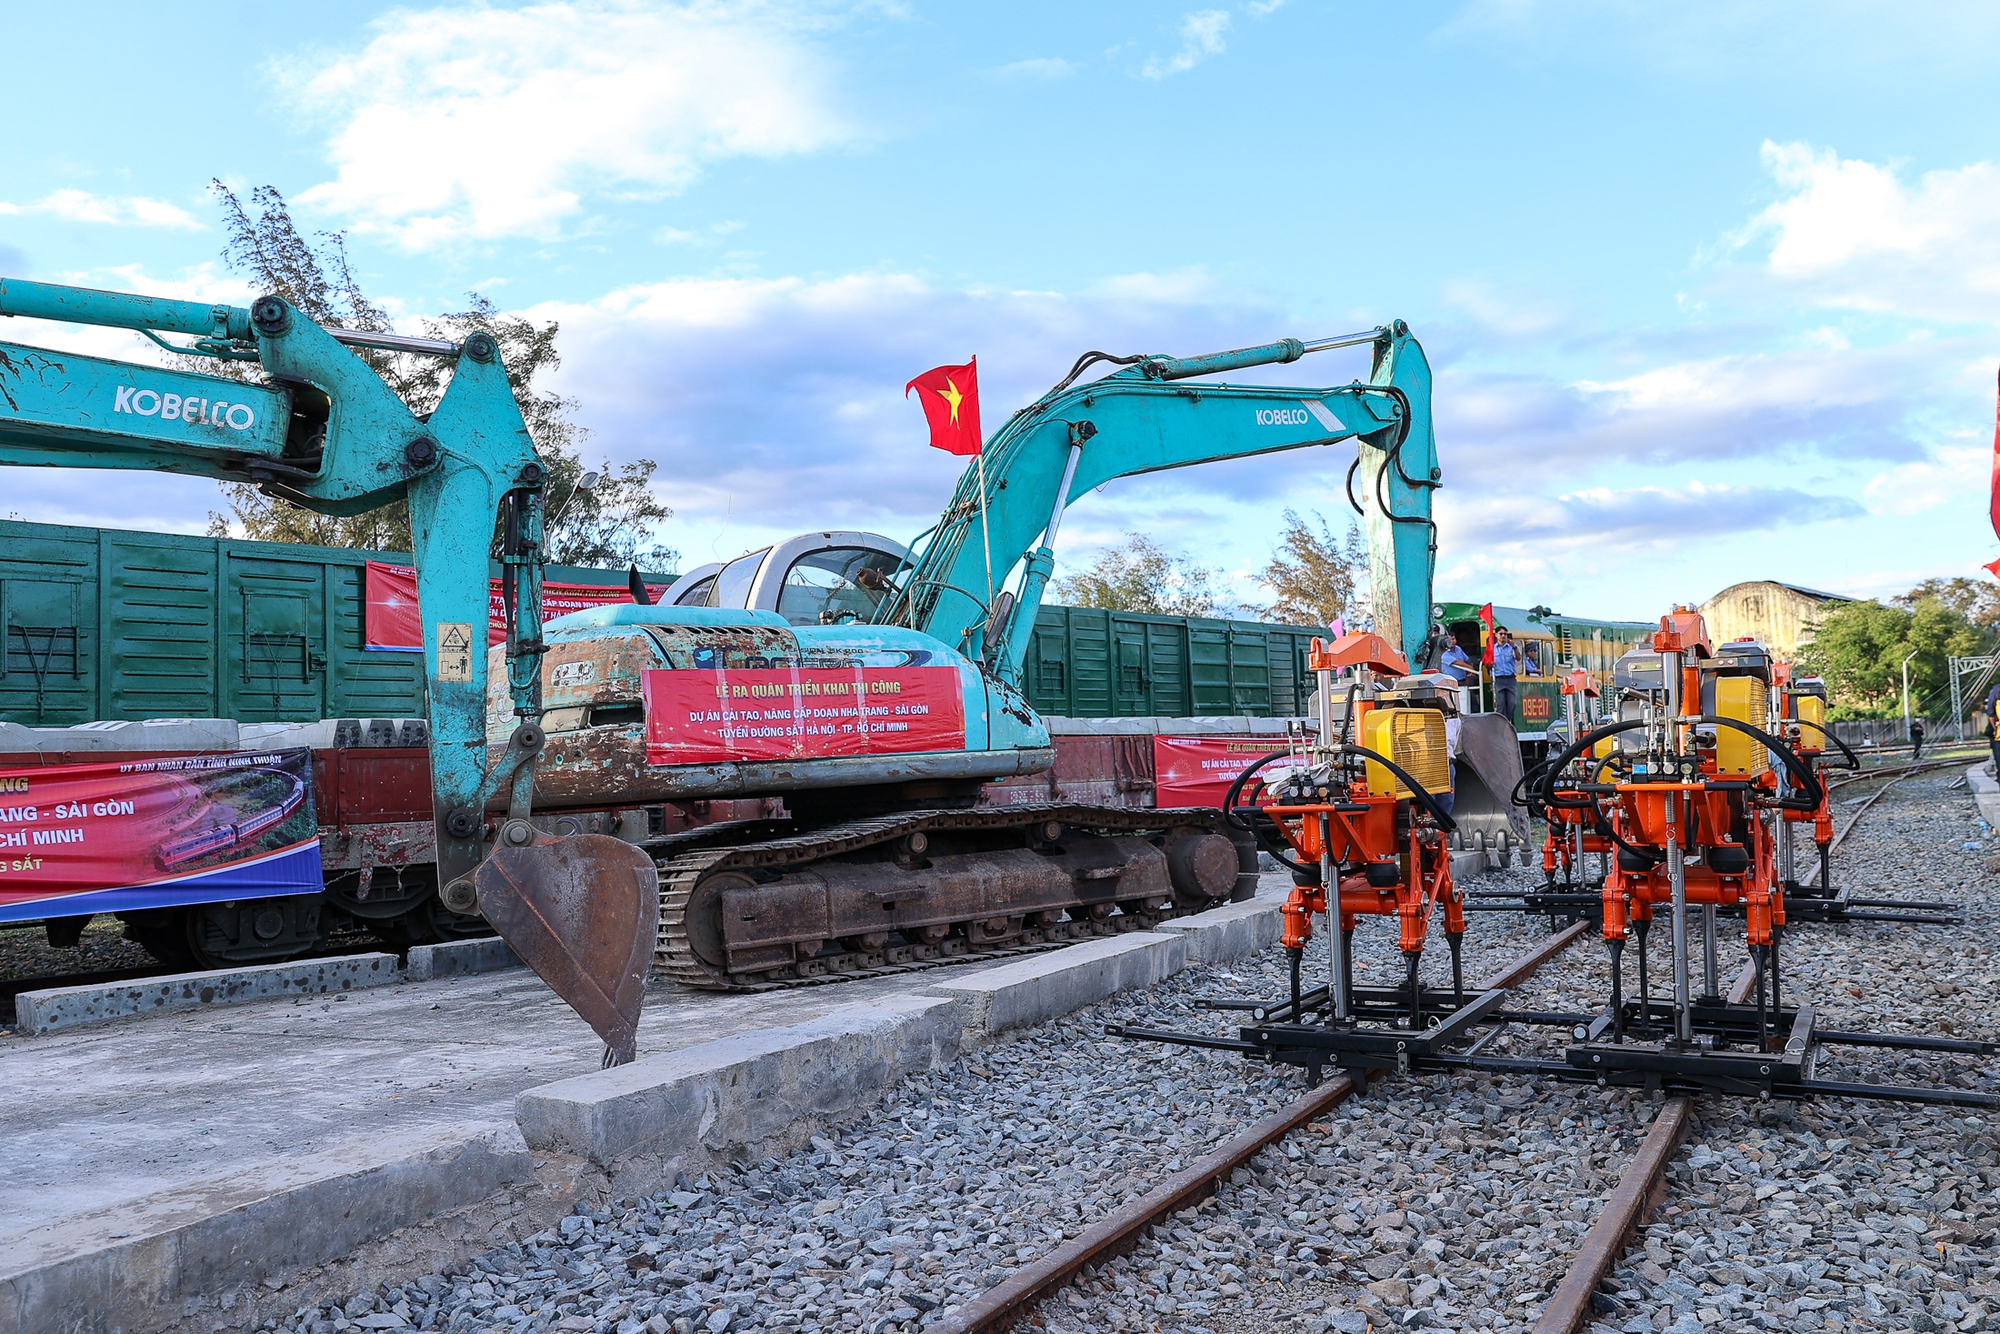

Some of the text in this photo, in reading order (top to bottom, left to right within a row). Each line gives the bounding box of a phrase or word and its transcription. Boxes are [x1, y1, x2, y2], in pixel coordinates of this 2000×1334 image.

[114, 385, 255, 430] KOBELCO
[1255, 409, 1308, 425] KOBELCO
[716, 679, 901, 699] LỄ RA QUÂN TRIỂN KHAI THI CÔNG
[690, 711, 704, 724] DỰ
[707, 709, 720, 721] ÁN
[722, 707, 738, 721] CẢI
[740, 711, 762, 723] TẠO,
[764, 708, 791, 720] NÂNG
[793, 705, 812, 719] CẤP
[814, 708, 838, 720] ĐOẠN
[841, 707, 858, 717] NHA
[860, 706, 889, 716] TRANG
[895, 703, 909, 715] SÀI
[911, 703, 929, 715] GÒN
[1523, 698, 1549, 716] D9E-217
[717, 724, 748, 738] TUYẾN
[751, 724, 784, 738] ĐƯỜNG
[786, 721, 804, 736] SẮT
[806, 723, 819, 735] HÀ
[821, 723, 836, 737] NỘI
[842, 724, 855, 733] TP.
[870, 720, 885, 732] CHÍ
[887, 722, 908, 732] MINH
[135, 762, 155, 772] BAN
[228, 756, 252, 767] NINH
[55, 800, 88, 819] SÀI
[92, 798, 134, 817] GÒN
[32, 828, 85, 845] MINH
[11, 852, 43, 872] SẮT
